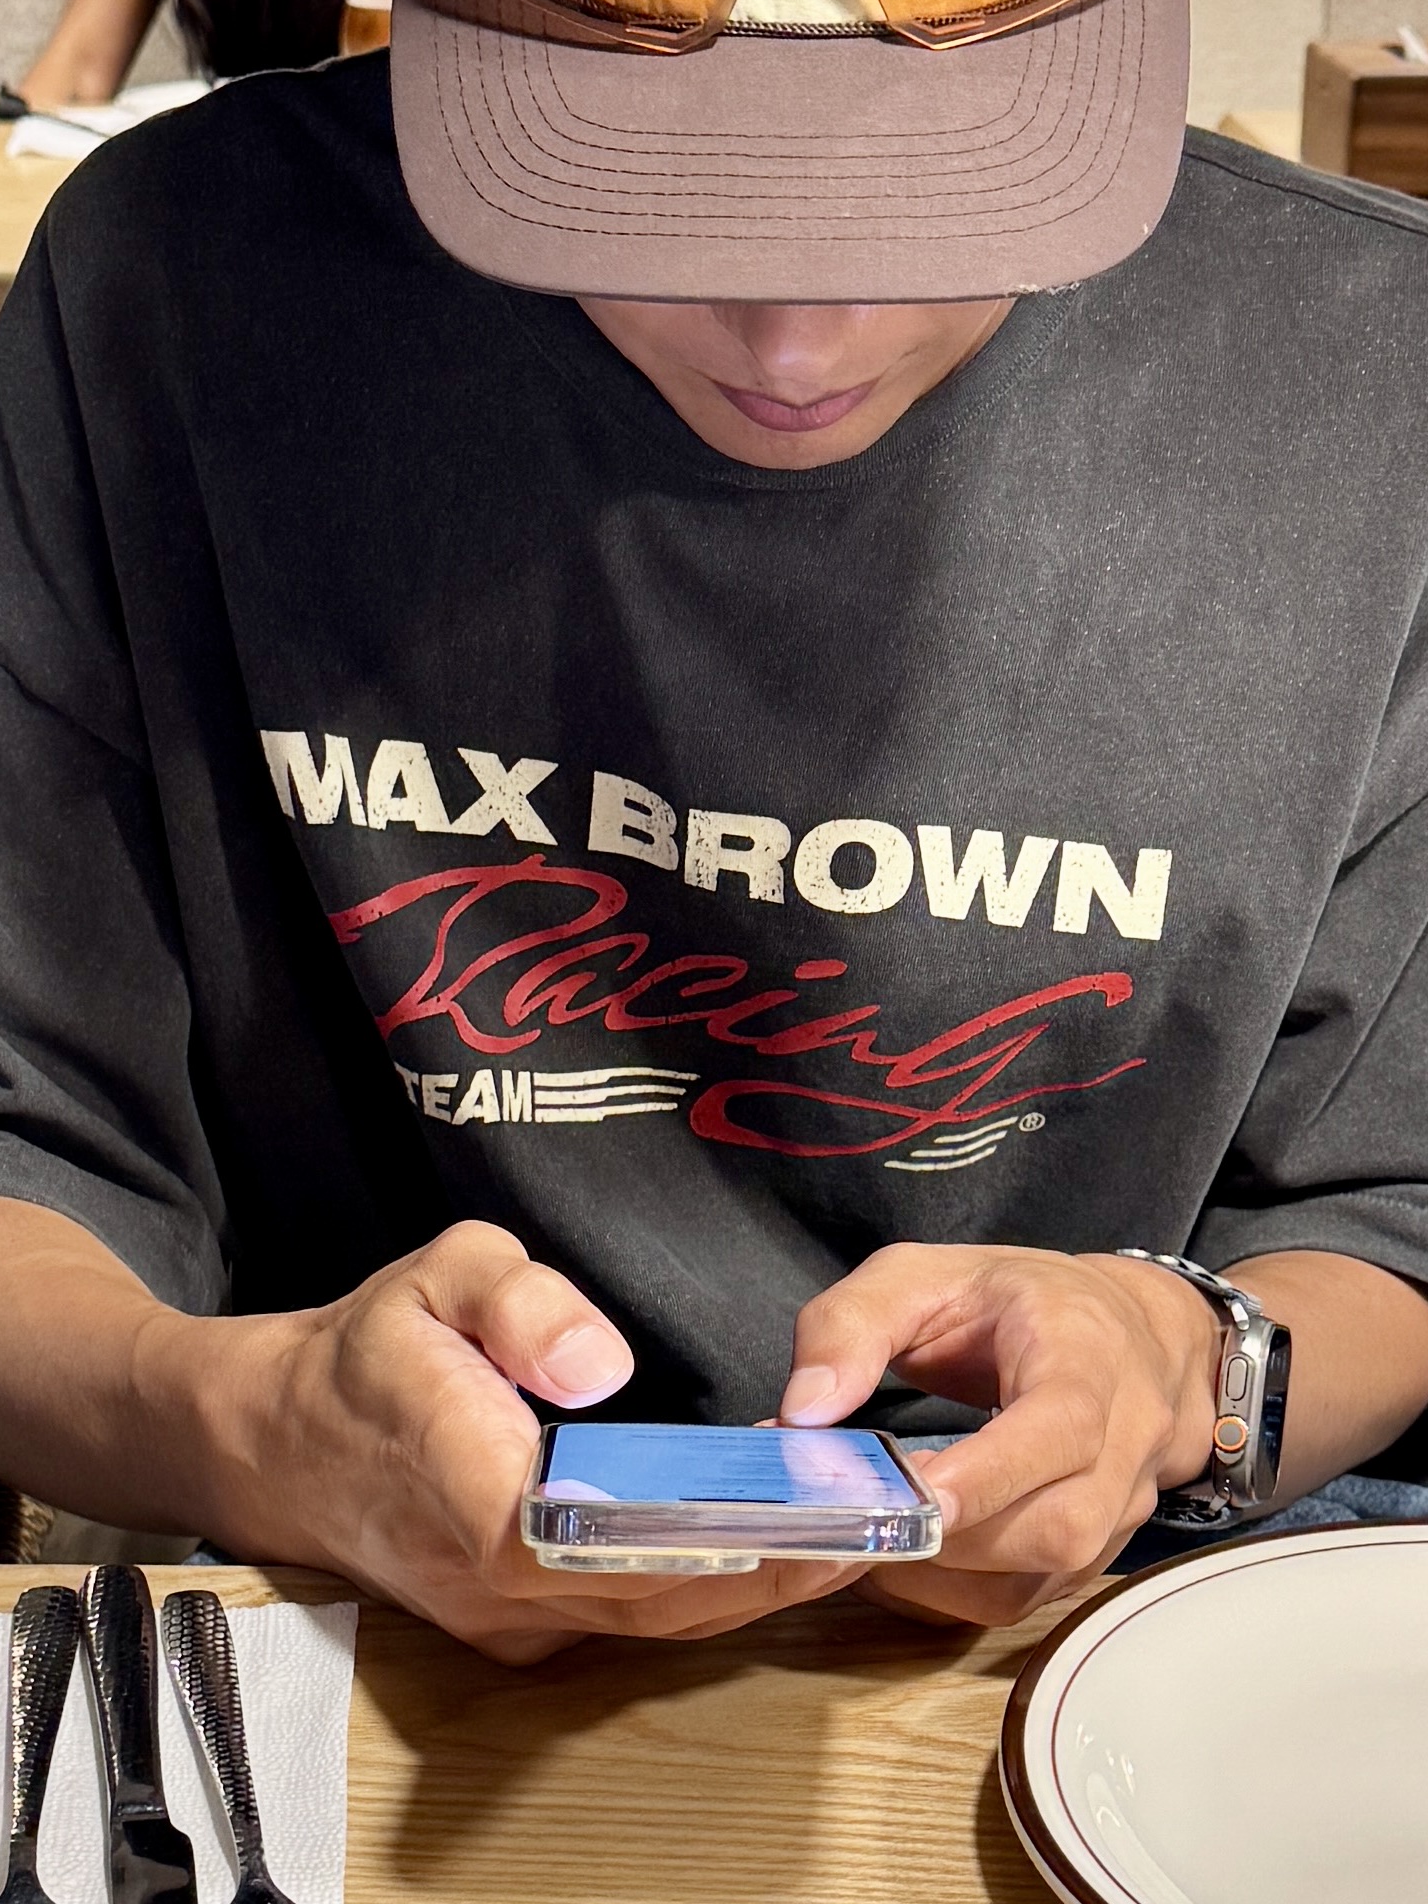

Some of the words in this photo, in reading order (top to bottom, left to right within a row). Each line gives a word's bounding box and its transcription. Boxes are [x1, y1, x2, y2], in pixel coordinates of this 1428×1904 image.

[260, 730, 558, 846] MAX
[587, 770, 1173, 941] BROWN
[329, 853, 1148, 1157] Racing
